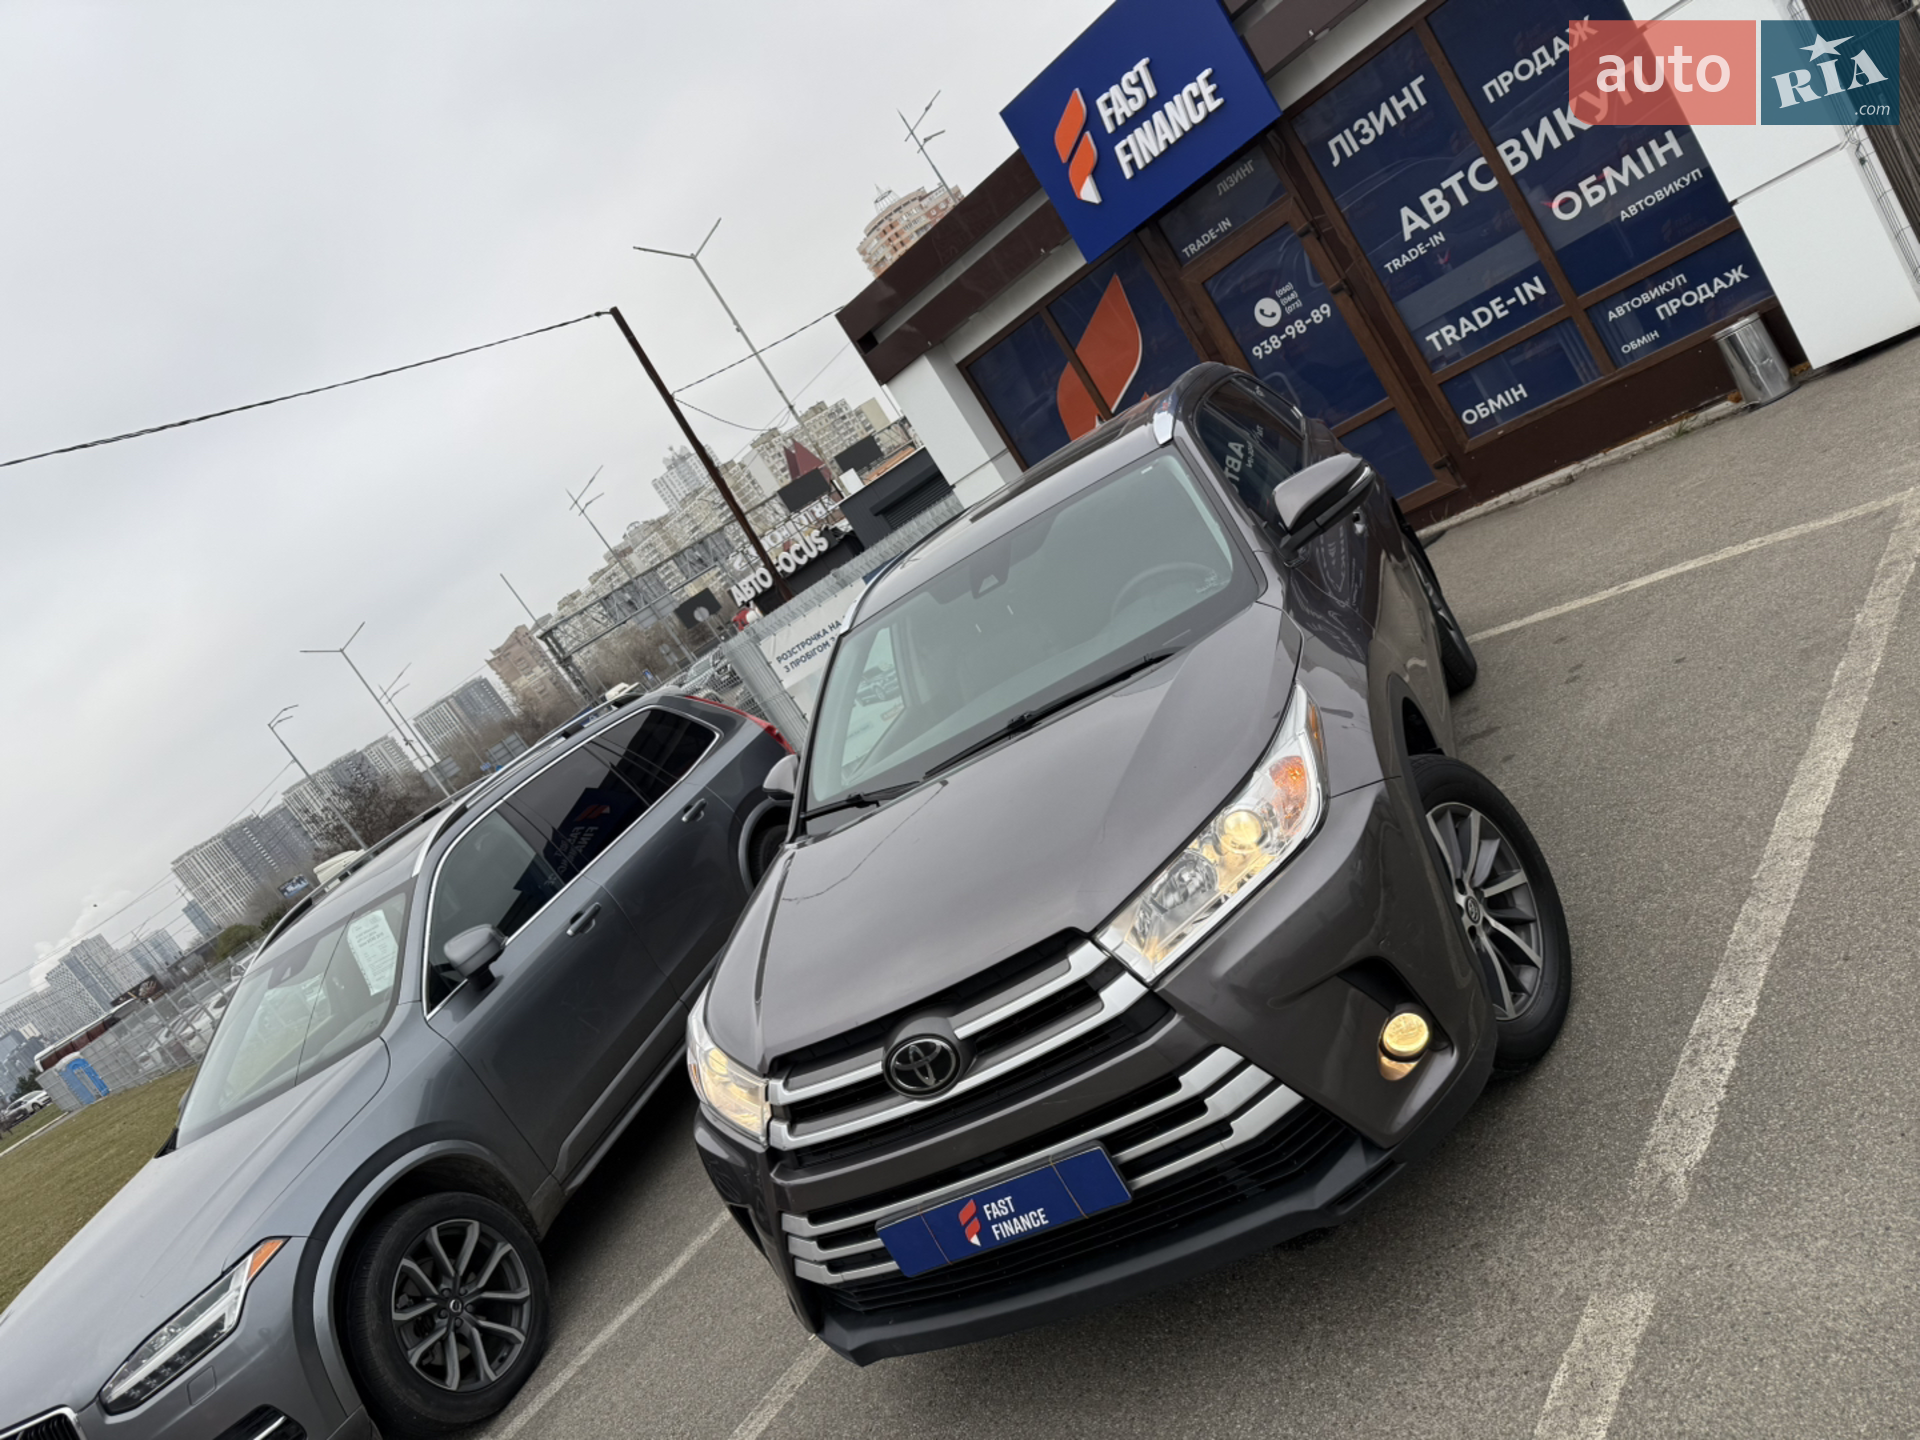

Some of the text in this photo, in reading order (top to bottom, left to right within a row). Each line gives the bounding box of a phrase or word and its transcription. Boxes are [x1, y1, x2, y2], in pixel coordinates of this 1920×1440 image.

[1481, 14, 1599, 104] ПРОДАЖ
[1095, 57, 1158, 134] FAST
[1114, 67, 1224, 180] FINANCE
[1327, 75, 1430, 167] ЛІЗИНГ
[1216, 159, 1256, 196] ЛІЗИНГ
[1551, 129, 1685, 221] ОБМІН
[1618, 168, 1703, 222] АВТОВИКУП
[1181, 217, 1233, 259] TRADE-IN
[1384, 229, 1446, 275] TRADE-IN
[1425, 275, 1547, 354] TRADE-IN
[1607, 273, 1688, 322] АВТОВИКУП
[1655, 265, 1750, 320] ПРОДАЖ
[1252, 303, 1331, 359] 938-98-89
[1620, 330, 1660, 354] ОБМІН
[1461, 384, 1528, 425] ОБМІН
[730, 567, 773, 607] АВТО
[776, 620, 842, 664] РОЗСТРОЧКА НА
[783, 640, 831, 673] З ПРОБІГОМ
[983, 1196, 1016, 1221] FAST
[991, 1207, 1049, 1241] FINANCE
